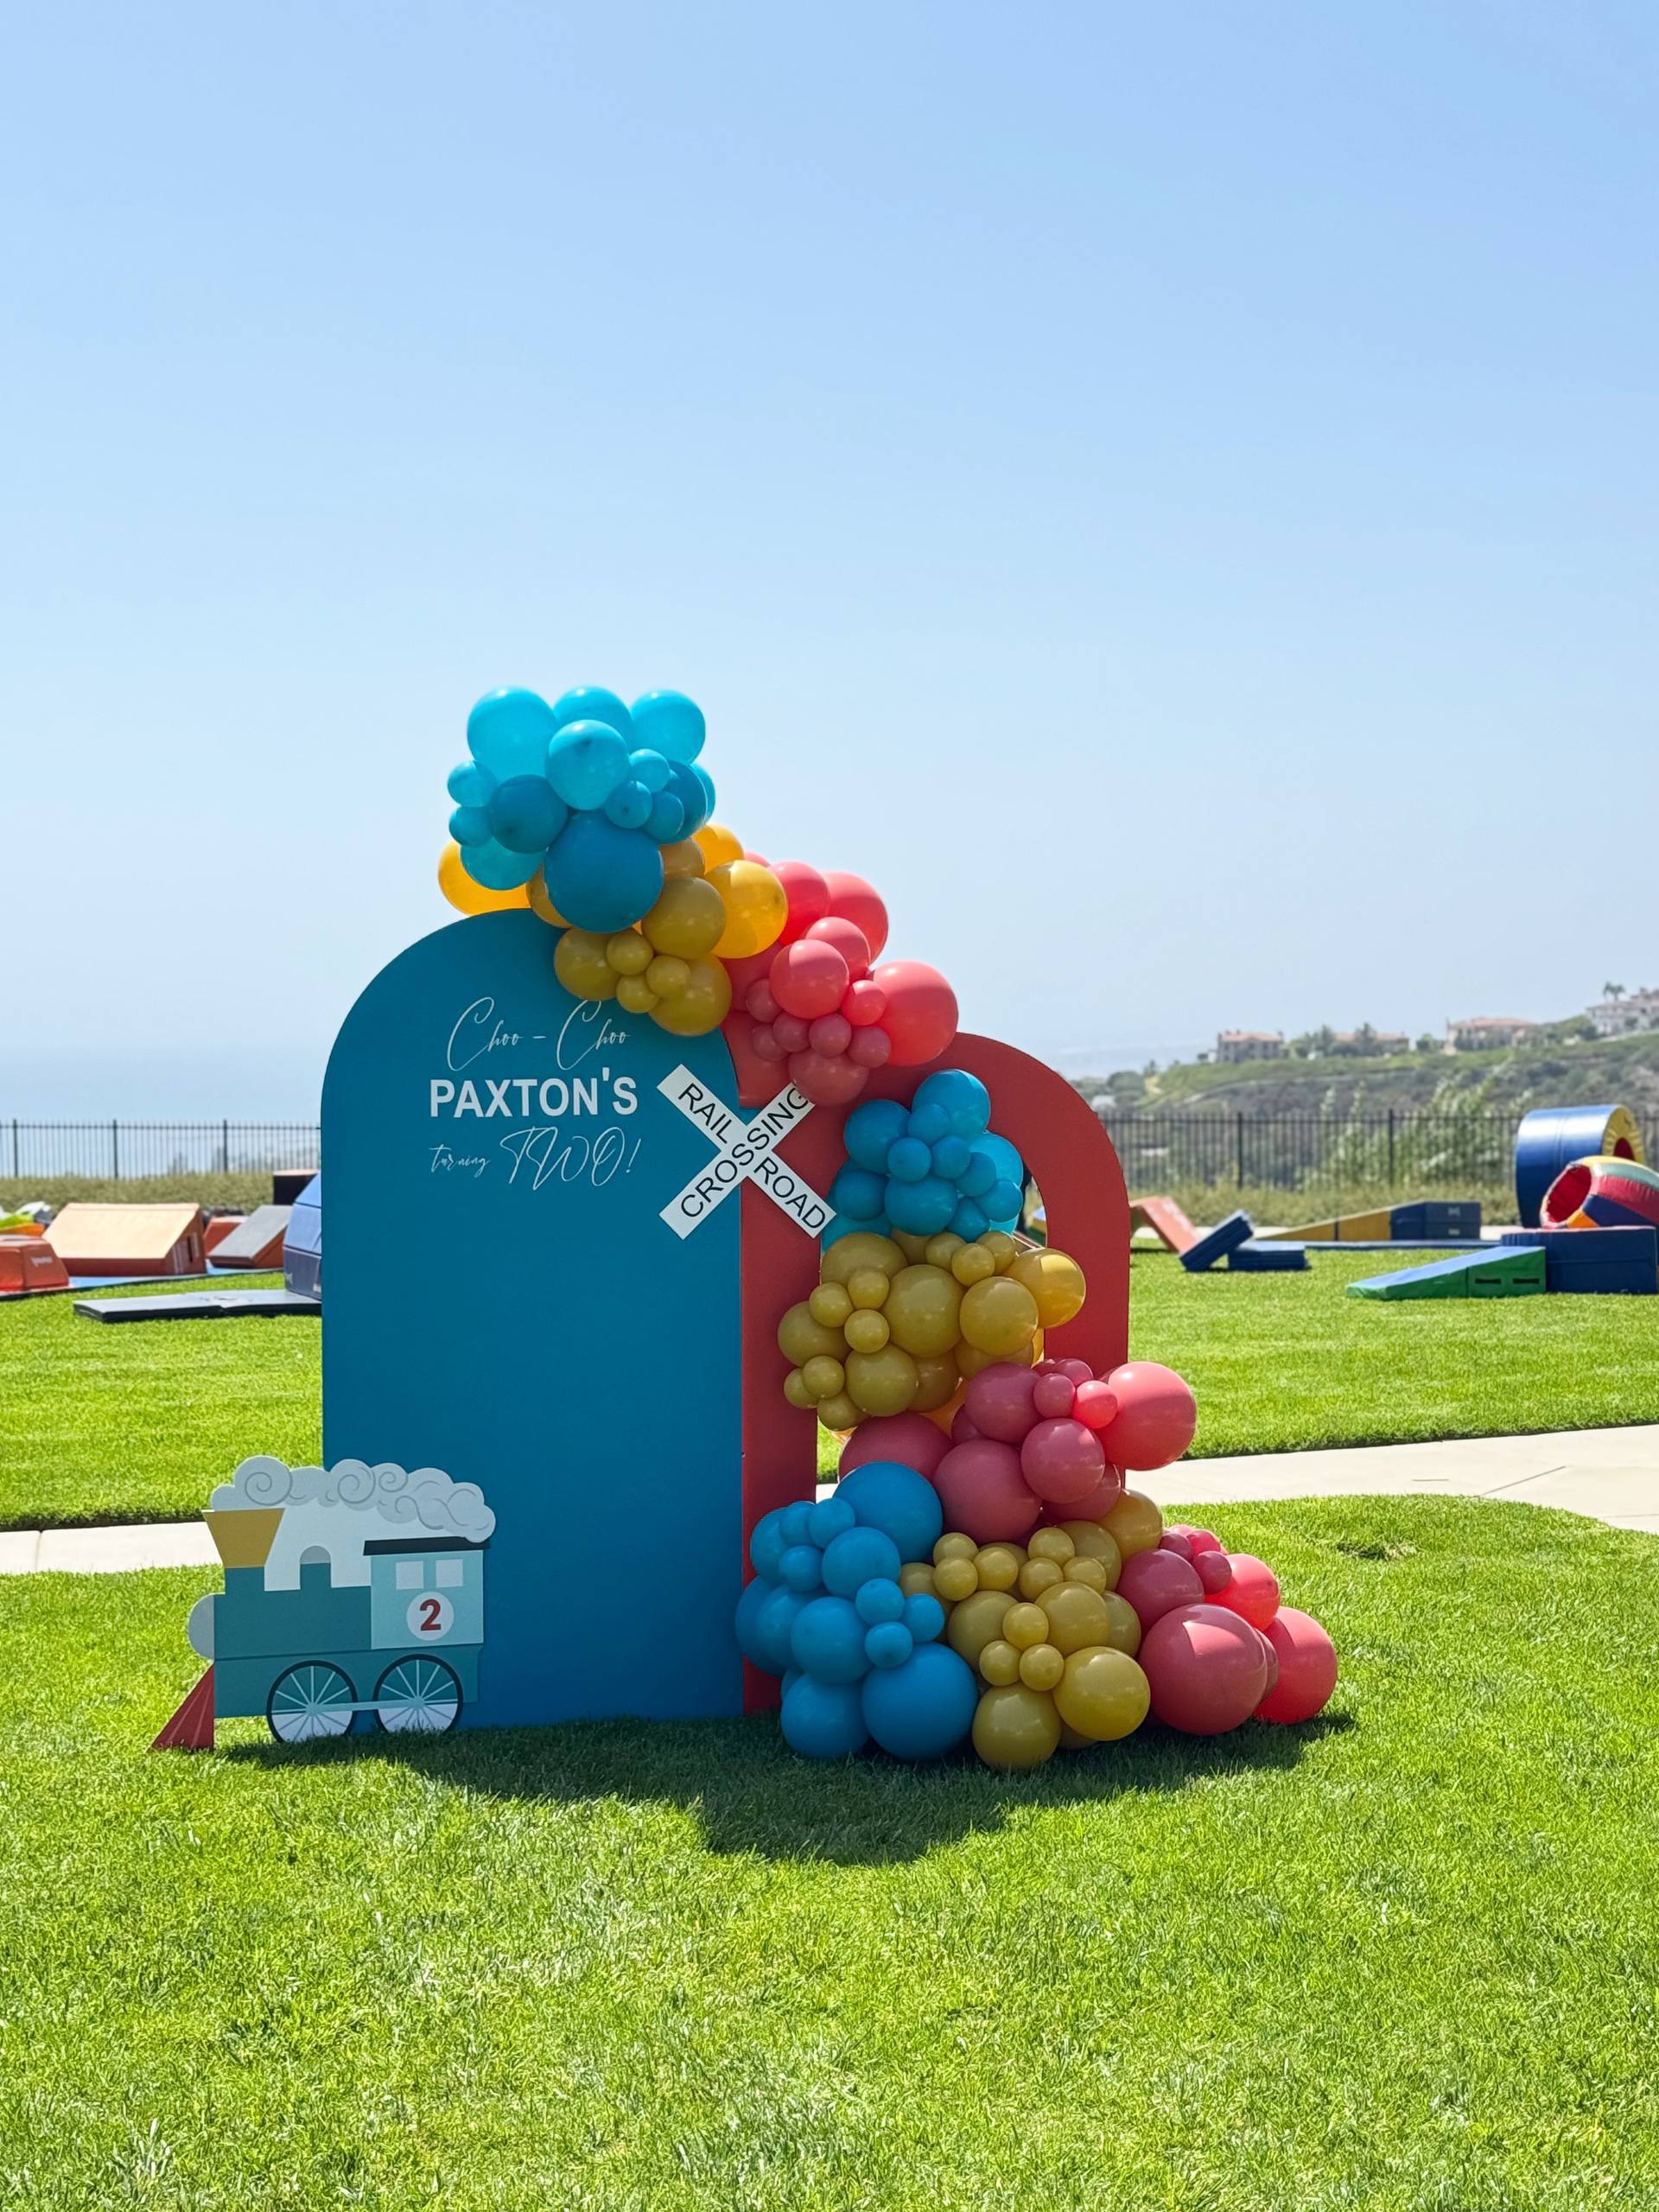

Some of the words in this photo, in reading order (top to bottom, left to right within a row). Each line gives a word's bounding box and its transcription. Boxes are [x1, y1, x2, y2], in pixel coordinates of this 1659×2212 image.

[446, 996, 523, 1071] Choo
[556, 999, 631, 1071] Choo
[429, 1067, 639, 1118] PAXTON'S
[429, 1143, 491, 1178] turning
[499, 1126, 642, 1191] TWO!
[677, 1083, 733, 1145] RAIL
[753, 1156, 826, 1229] ROAD
[680, 1087, 809, 1217] CROSSING
[418, 1598, 442, 1632] 2
